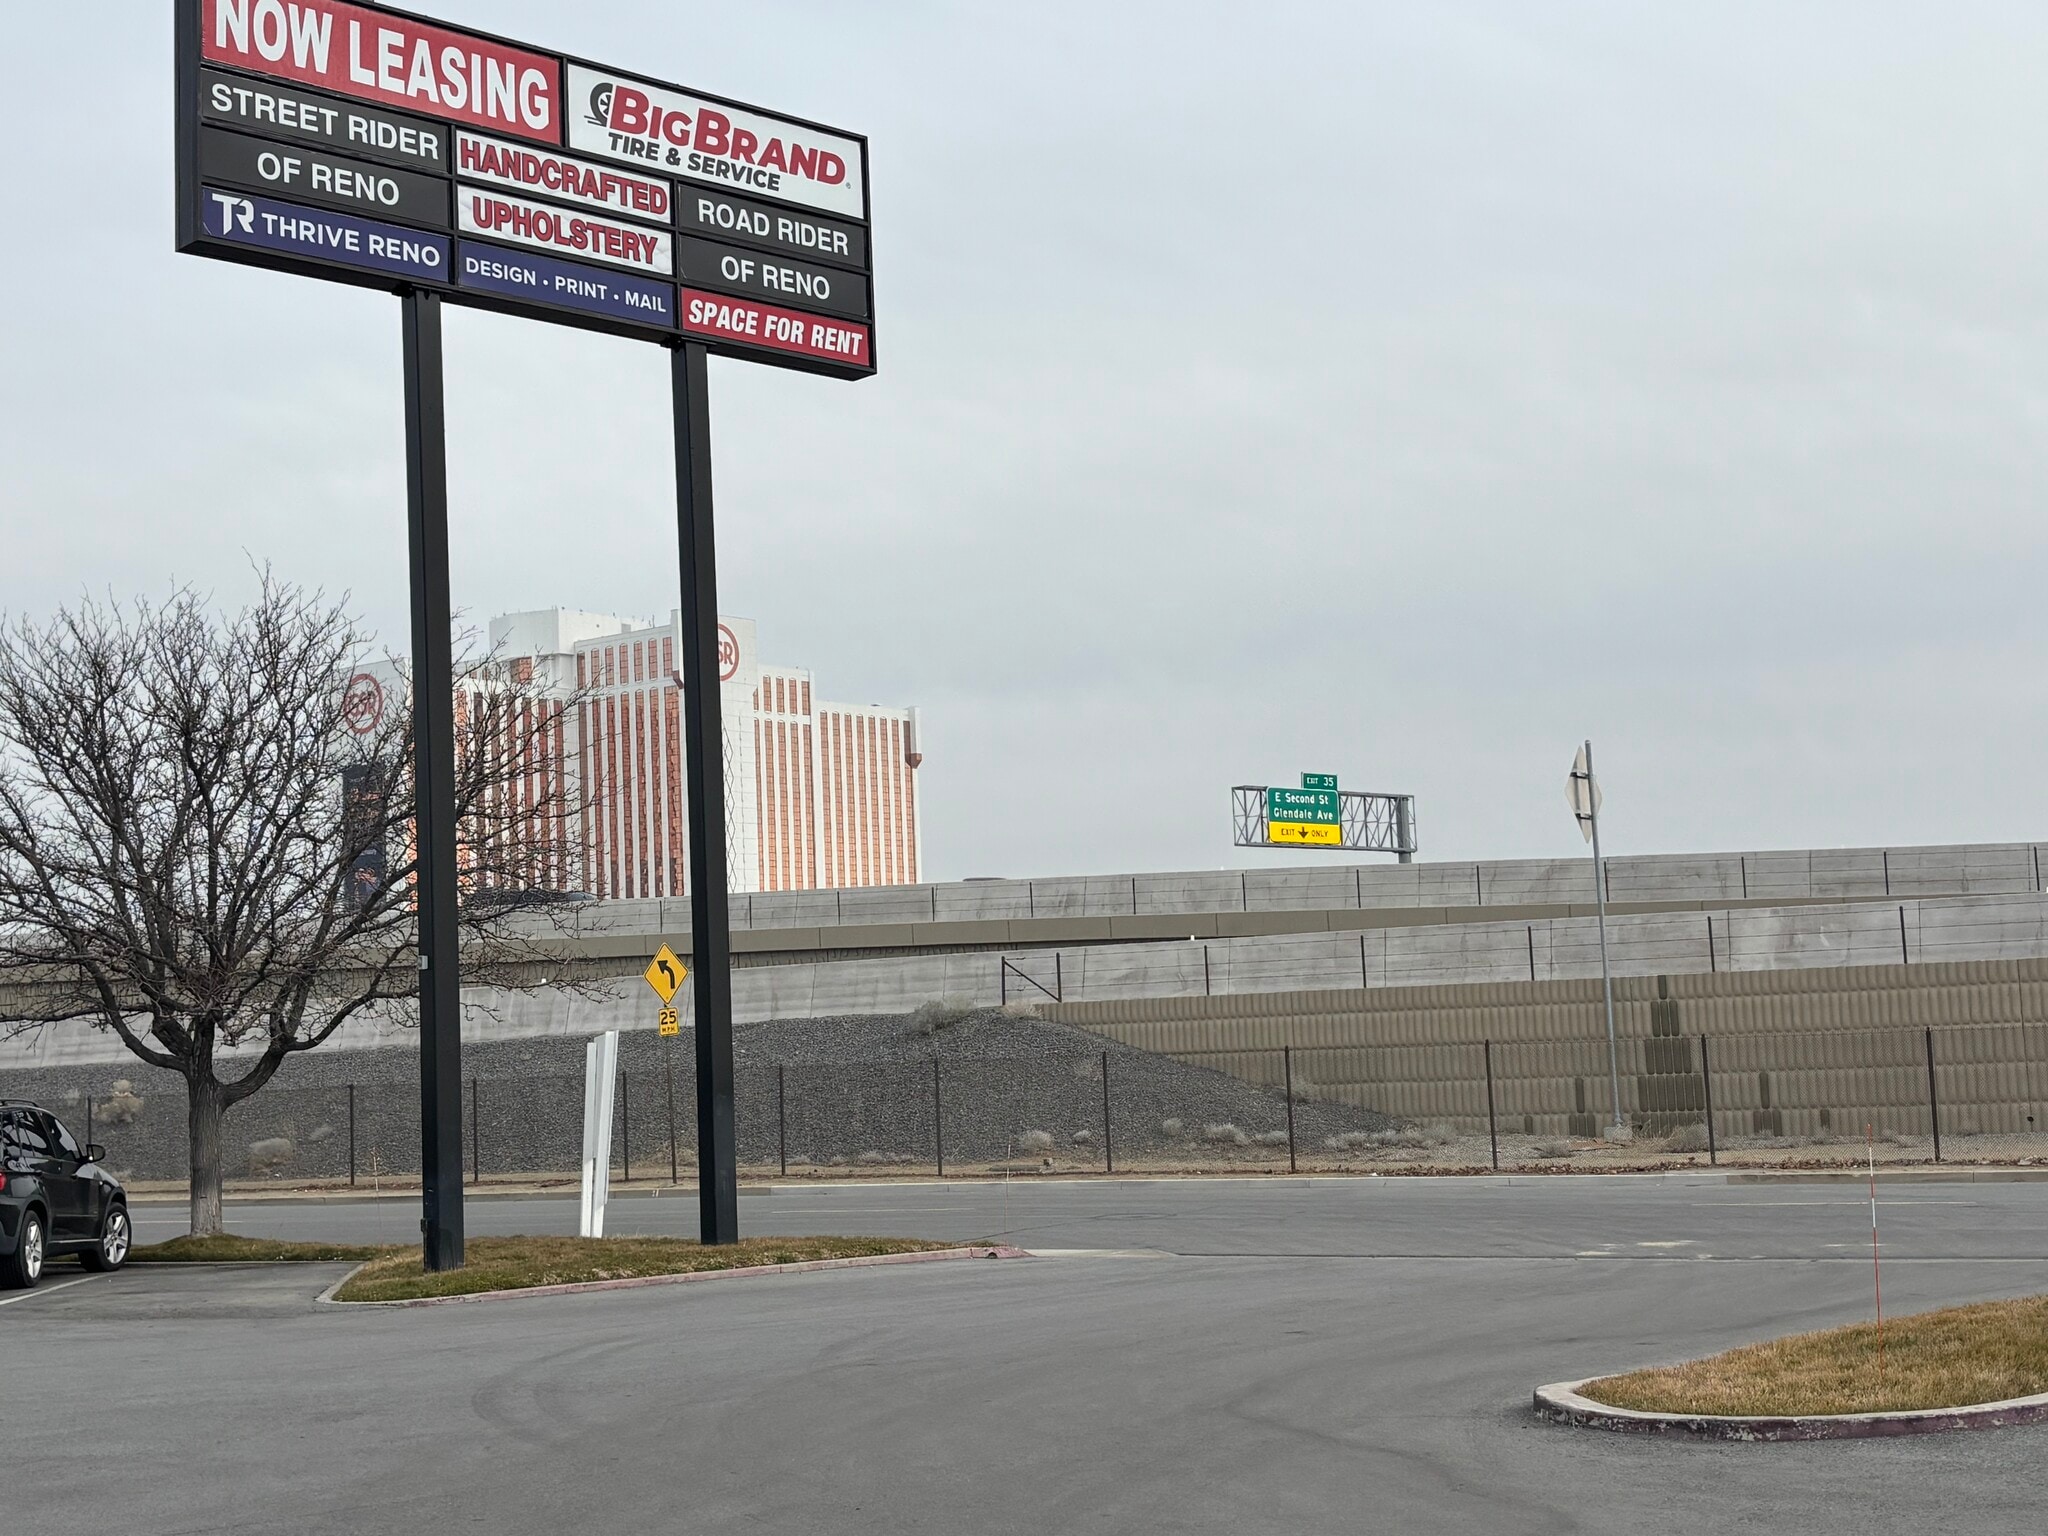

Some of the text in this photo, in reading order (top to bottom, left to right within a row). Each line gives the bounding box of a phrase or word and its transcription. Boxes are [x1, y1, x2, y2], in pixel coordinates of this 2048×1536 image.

[215, 0, 551, 130] NOW LEASING
[211, 83, 440, 161] STREET RIDER
[257, 152, 400, 206] OF RENO
[459, 138, 668, 215] HANDCRAFTED
[608, 132, 781, 192] TIRE & SERVICE
[261, 212, 441, 267] THRIVE RENO
[472, 196, 658, 264] UPHOLSTERY
[698, 198, 849, 256] ROAD RIDER
[465, 257, 667, 313] DESIGN PRINT MAIL
[721, 255, 831, 300] OF RENO
[688, 300, 863, 356] SPACE FOR RENT
[1275, 792, 1329, 805] E Second St
[1323, 777, 1334, 787] 35
[1274, 808, 1333, 820] Glendale Ave
[1281, 828, 1329, 838] EXIT ONLY
[661, 1011, 677, 1025] 25
